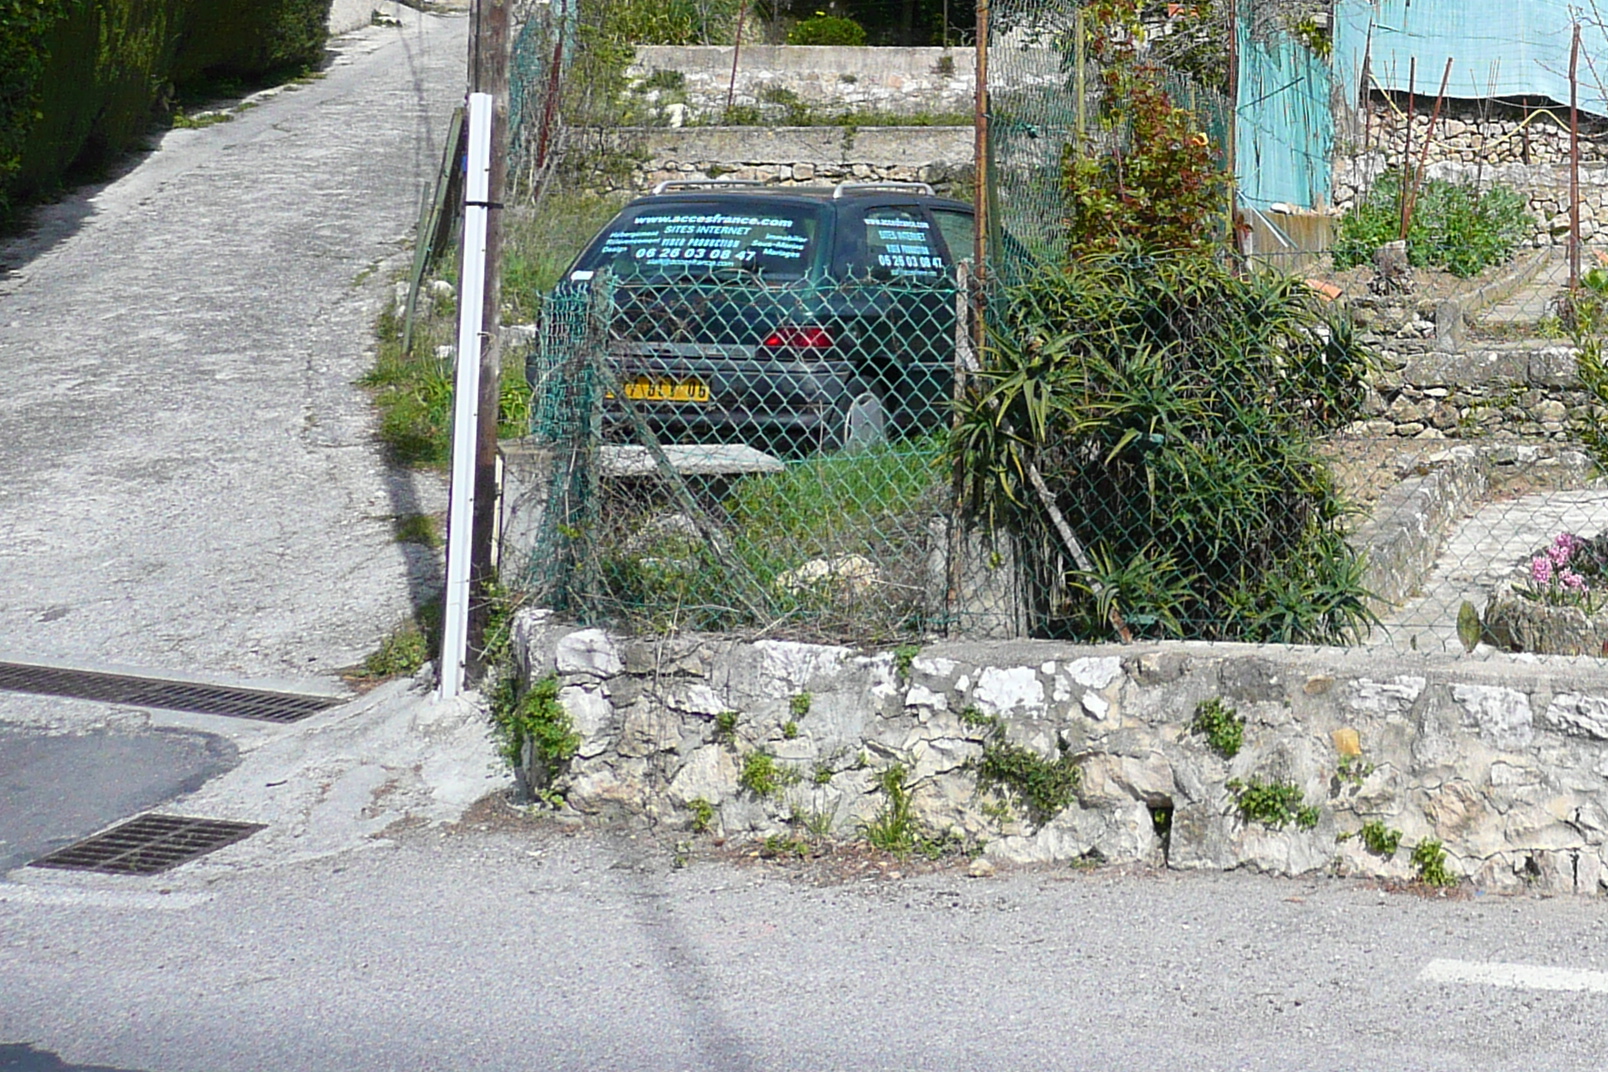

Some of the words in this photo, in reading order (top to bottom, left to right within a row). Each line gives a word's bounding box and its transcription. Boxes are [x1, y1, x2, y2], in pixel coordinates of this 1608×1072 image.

[634, 214, 794, 228] www.accesfrance.com
[663, 225, 696, 234] SITES
[696, 225, 752, 236] INTERNET
[635, 248, 657, 259] 06
[659, 248, 682, 259] 26
[683, 248, 707, 259] 03
[709, 248, 732, 260] 08
[735, 250, 757, 262] 47
